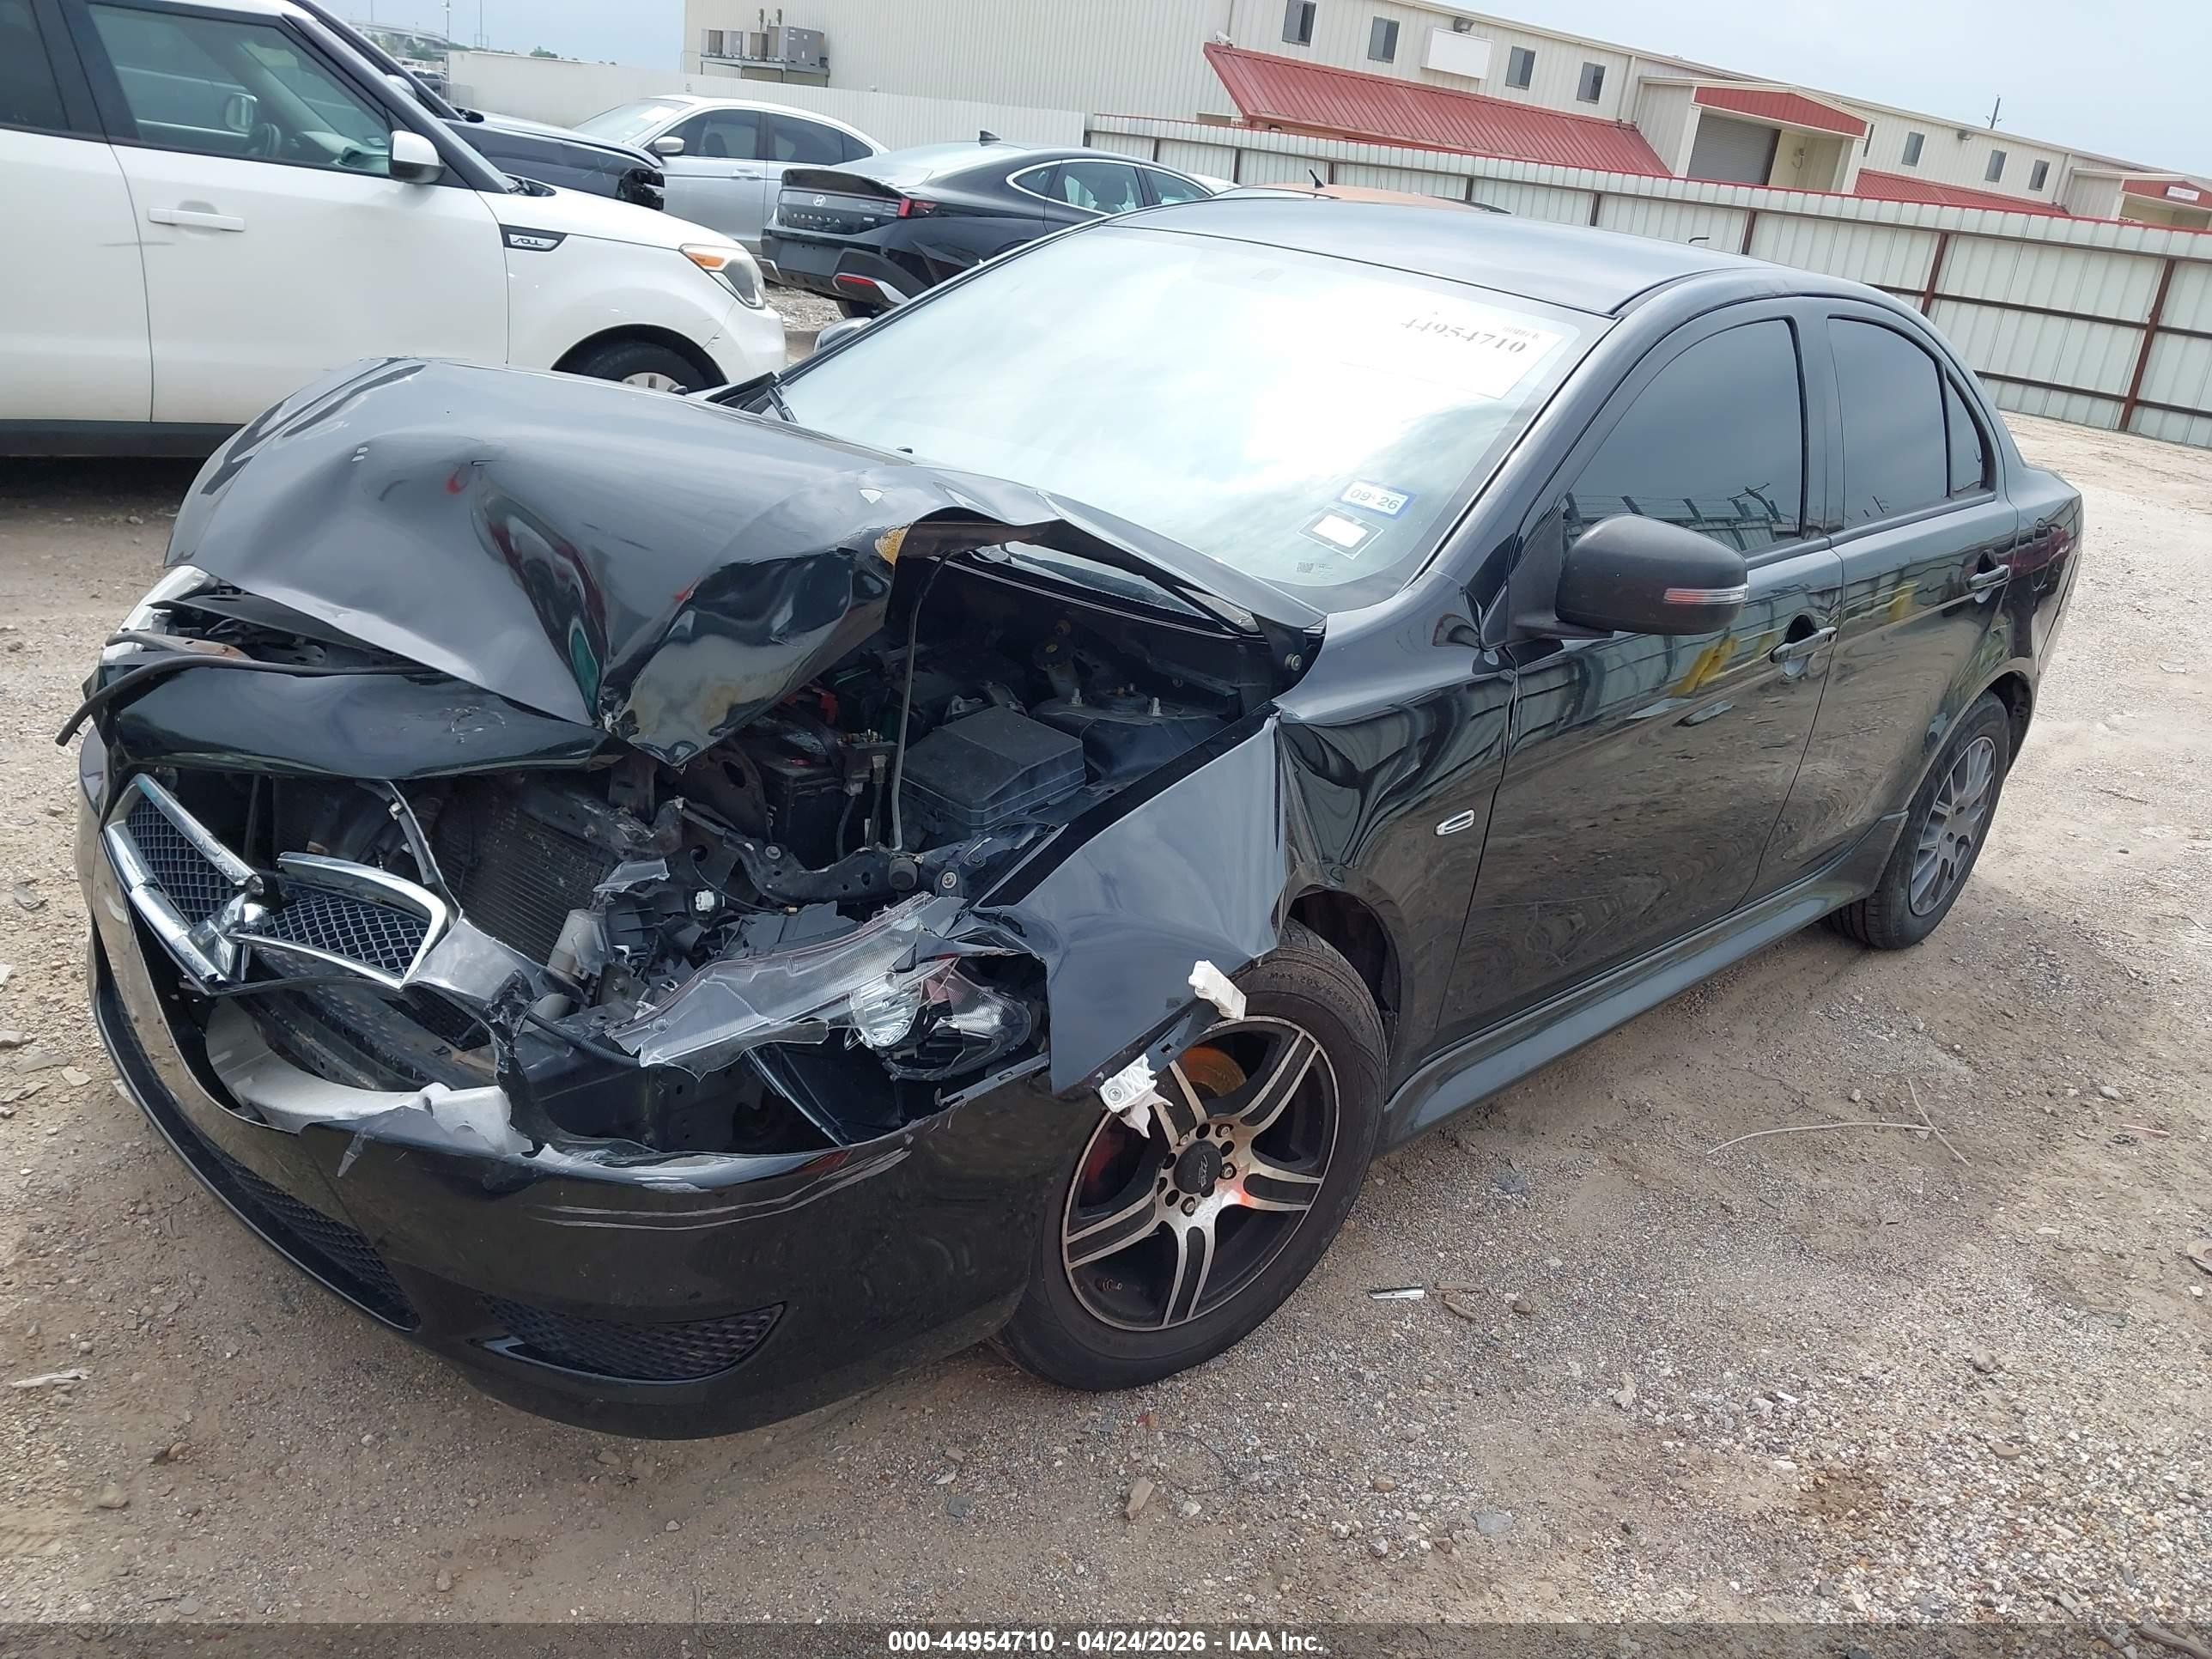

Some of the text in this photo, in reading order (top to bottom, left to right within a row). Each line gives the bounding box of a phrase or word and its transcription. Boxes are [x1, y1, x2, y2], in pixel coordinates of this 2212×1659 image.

[1401, 319, 1527, 353] 44954710
[1350, 489, 1399, 509] 09 26
